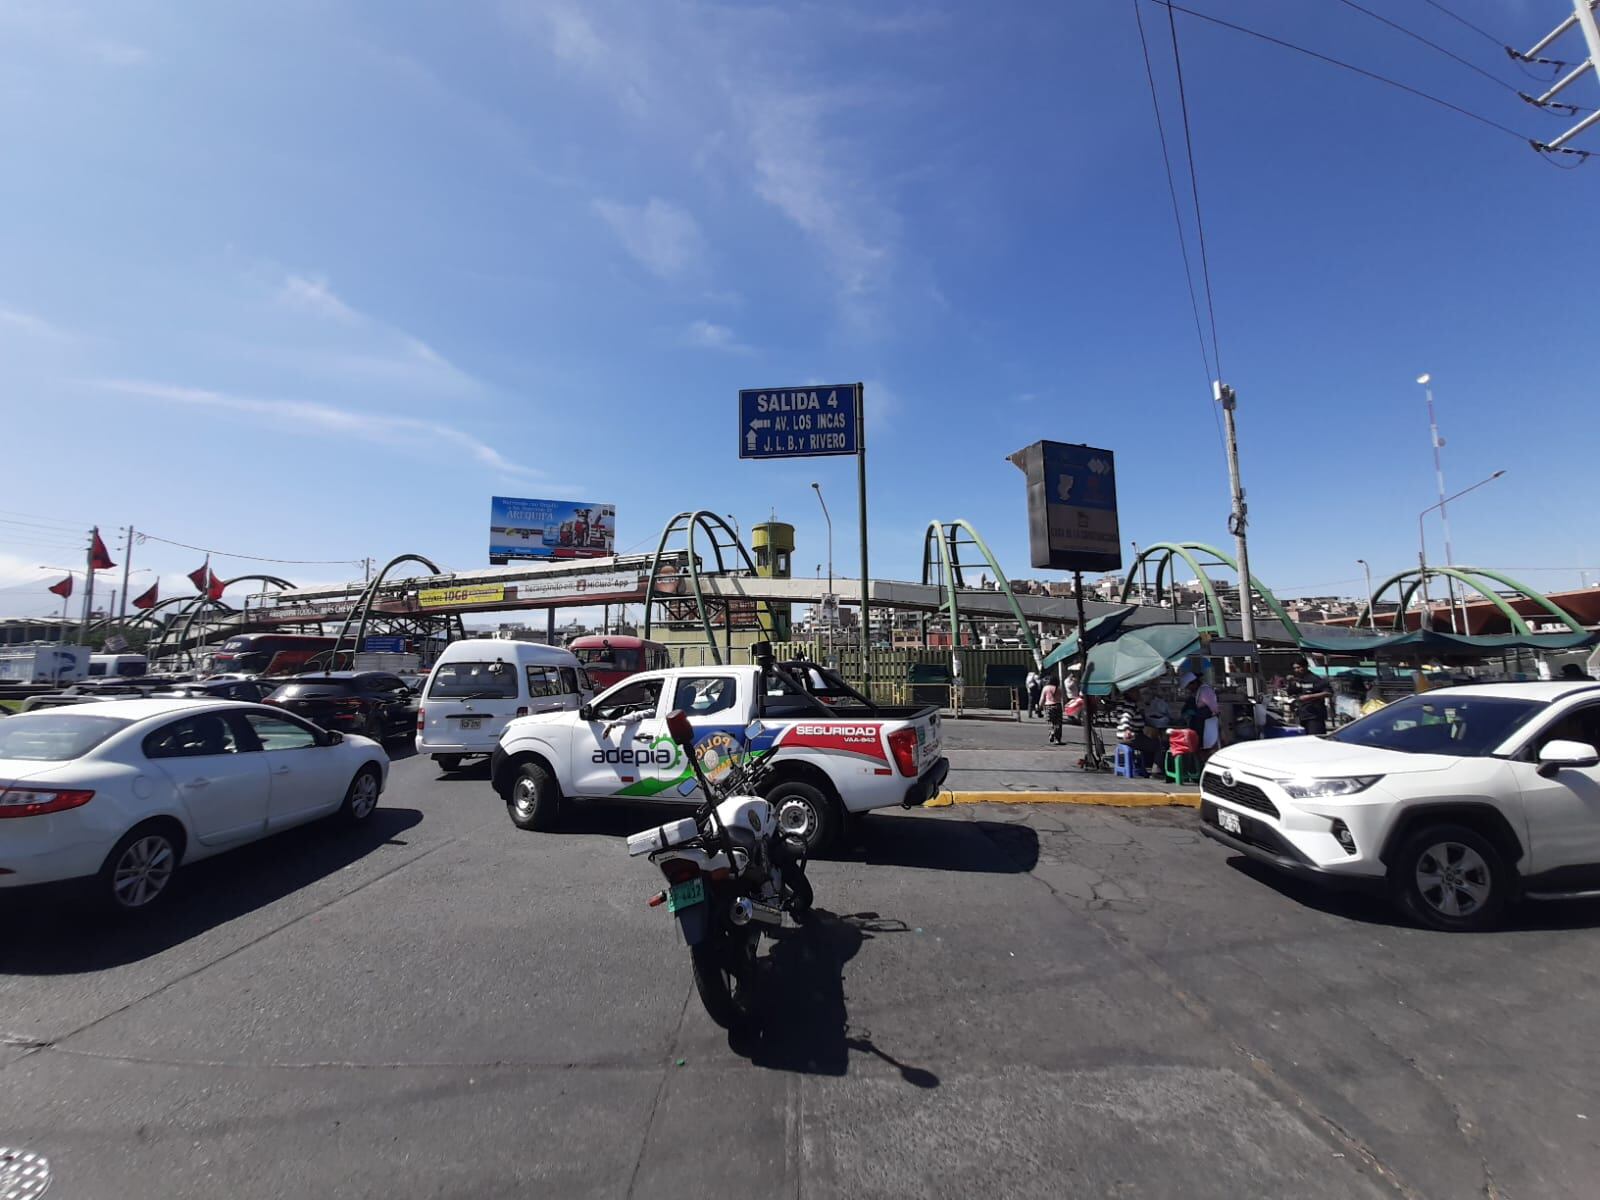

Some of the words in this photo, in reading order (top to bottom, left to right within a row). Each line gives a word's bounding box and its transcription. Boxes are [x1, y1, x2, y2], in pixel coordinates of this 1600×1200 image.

[757, 391, 820, 413] SALIDA
[827, 390, 838, 409] 4
[775, 416, 790, 431] AV.
[793, 414, 812, 430] LOS
[817, 412, 846, 430] INCAS
[810, 432, 846, 449] RIVERO
[444, 589, 468, 602] 10GB
[796, 726, 876, 736] SEGURIDAD
[592, 748, 671, 767] adepia
